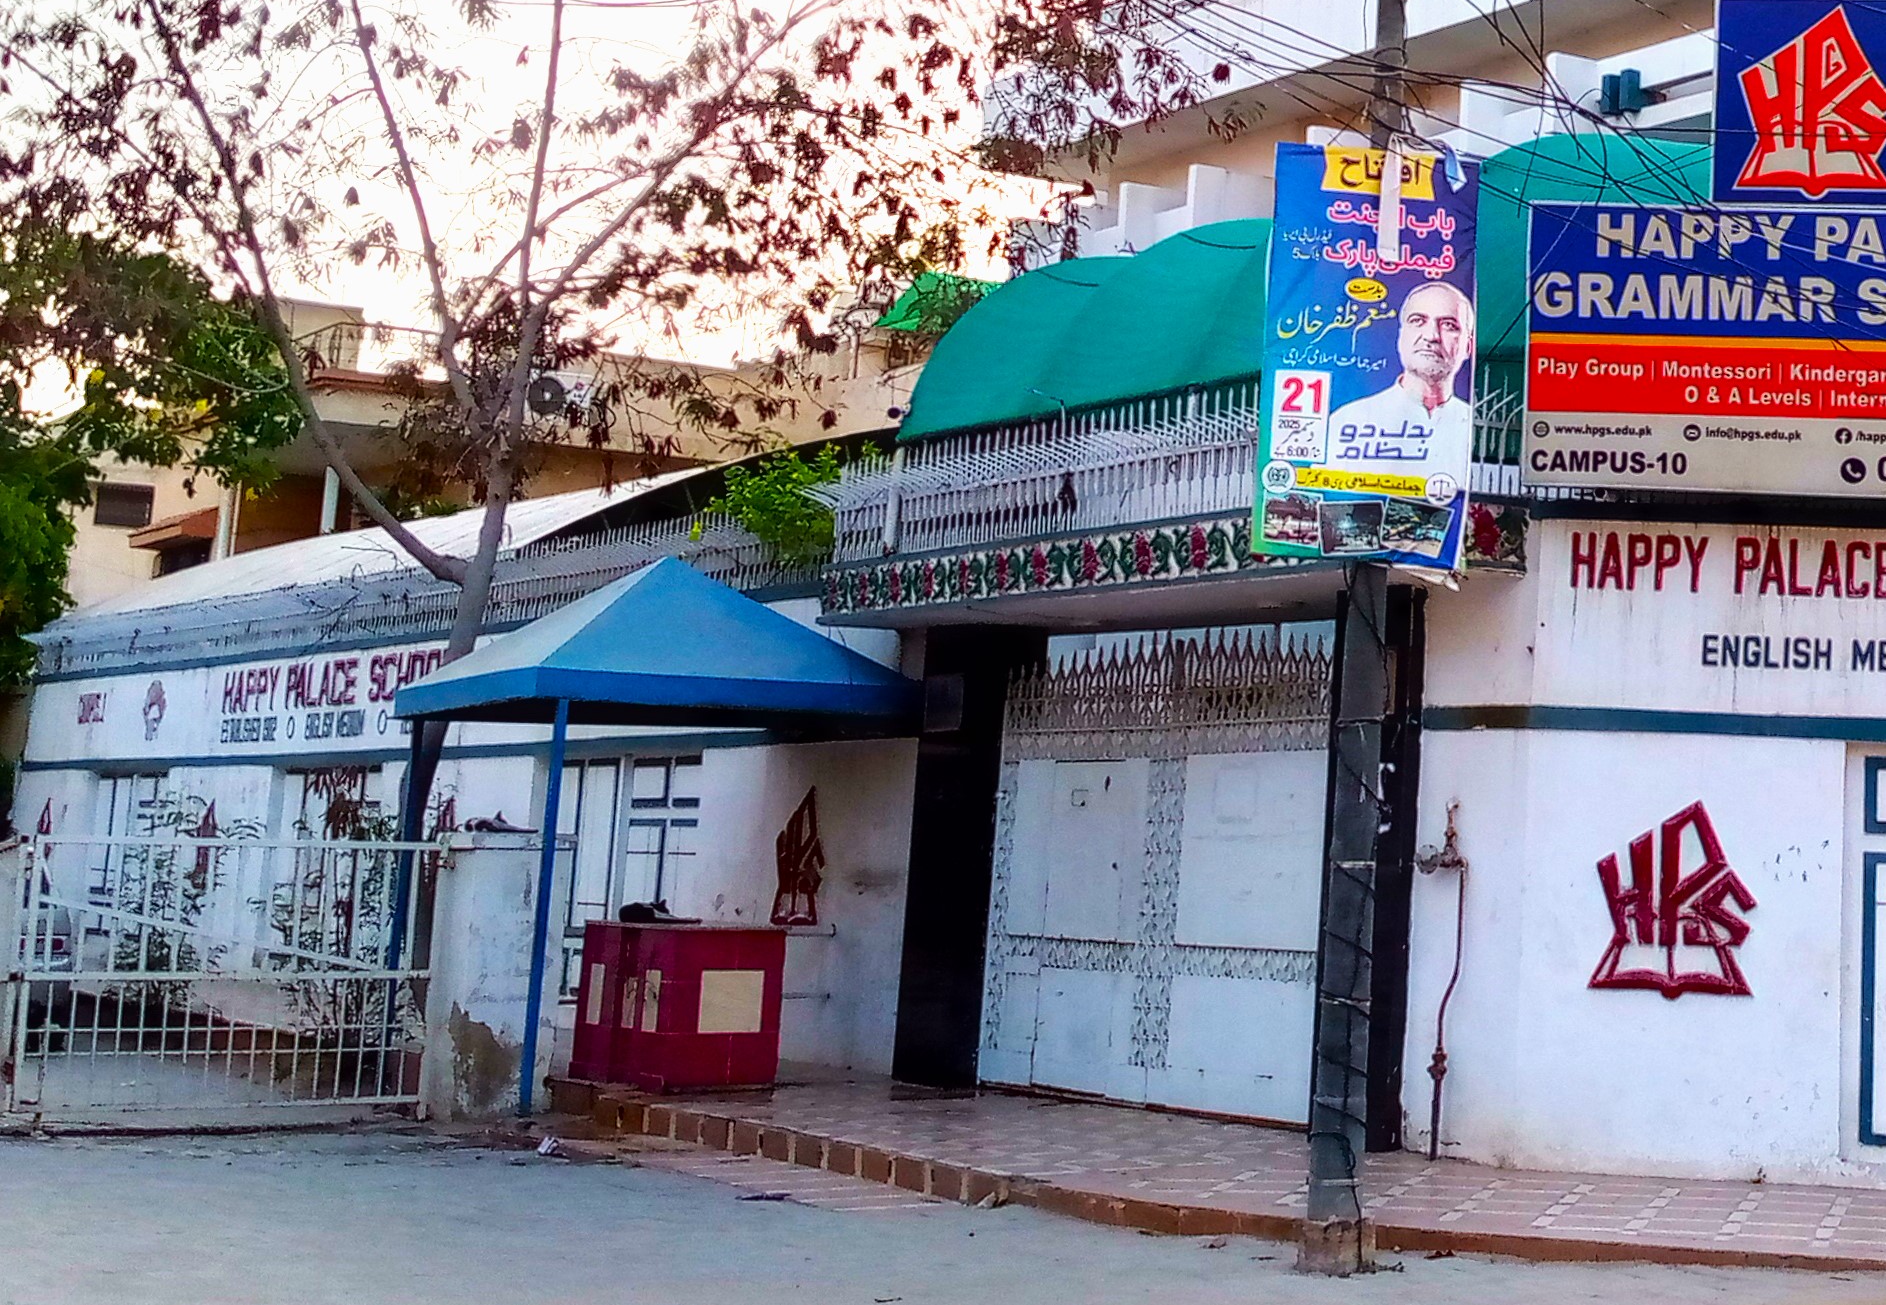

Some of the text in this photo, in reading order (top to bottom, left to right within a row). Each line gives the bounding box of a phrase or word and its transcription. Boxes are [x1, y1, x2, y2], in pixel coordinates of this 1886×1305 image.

[1406, 206, 1456, 241] باب
[1596, 213, 1795, 261] HAPPY
[1534, 271, 1837, 325] GRAMMAR
[1276, 304, 1324, 339] خان
[1309, 299, 1359, 344] ظفر
[1537, 357, 1578, 379] Play
[1585, 358, 1644, 381] Group
[1662, 360, 1771, 380] Montessori
[1281, 377, 1323, 413] 21
[1684, 386, 1699, 403] O
[1706, 386, 1720, 404] &
[1728, 387, 1742, 405] A
[1748, 388, 1812, 407] Levels
[1278, 419, 1300, 430] 2025
[1554, 421, 1652, 439] www.hpgs.edu.pk
[1705, 425, 1802, 442] info@hpgs.edu.pk
[1286, 446, 1309, 458] 6:00
[1530, 449, 1688, 475] CAMPUS-10
[1570, 530, 1709, 592] HAPPY
[1700, 634, 1833, 672] ENGLISH
[221, 665, 281, 715] HAPPY
[284, 656, 359, 710] PALACE
